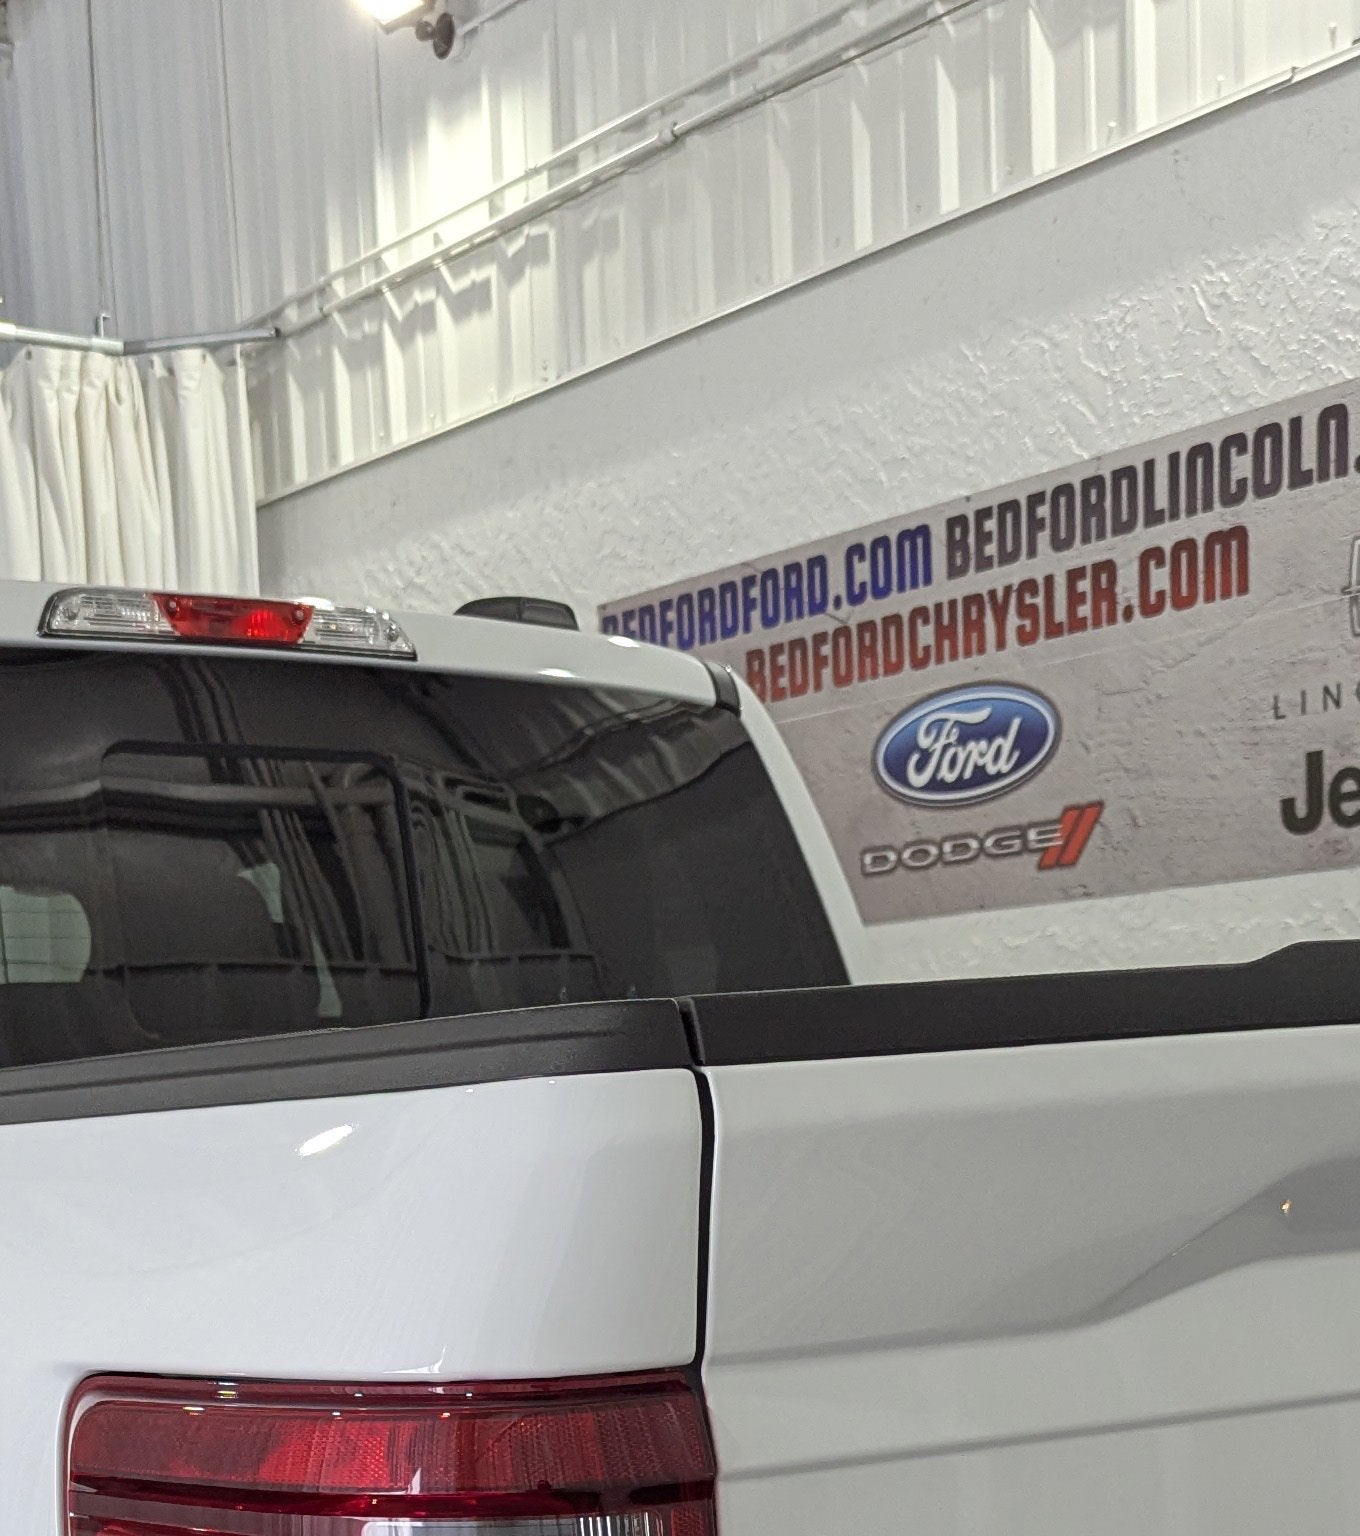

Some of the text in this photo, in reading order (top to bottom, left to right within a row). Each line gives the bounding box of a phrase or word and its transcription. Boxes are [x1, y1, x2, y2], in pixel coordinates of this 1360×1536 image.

[745, 524, 1251, 704] BEDFORDCHRYSLER.COM
[906, 707, 1023, 788] Ford
[860, 818, 1064, 878] DODGE
